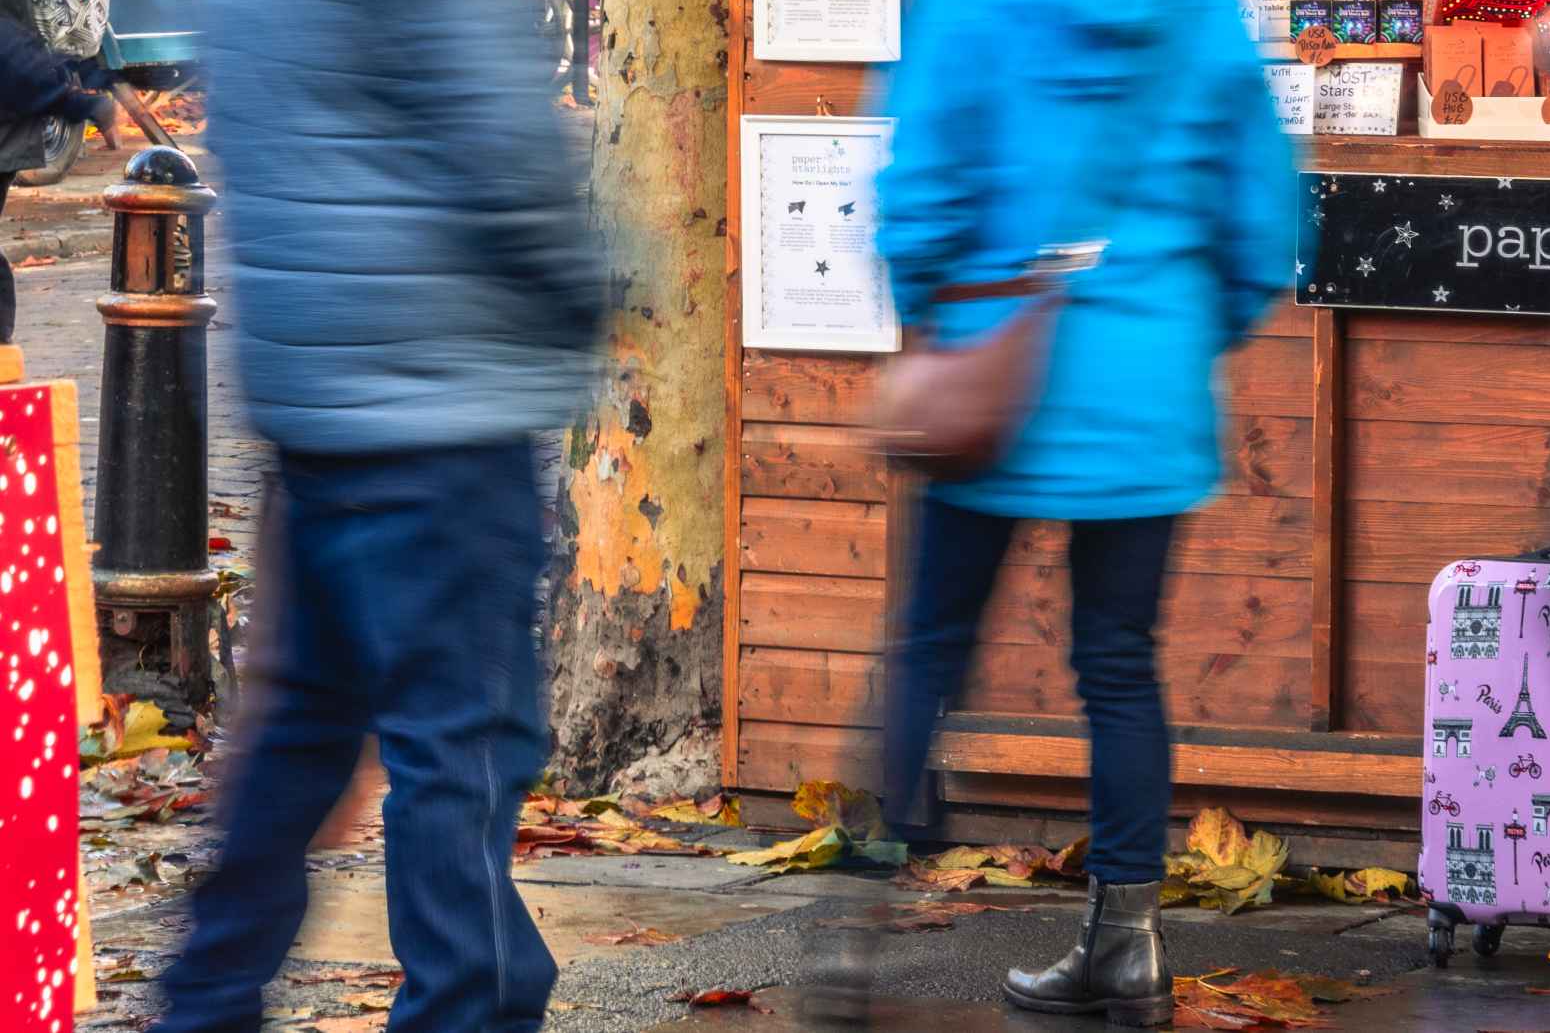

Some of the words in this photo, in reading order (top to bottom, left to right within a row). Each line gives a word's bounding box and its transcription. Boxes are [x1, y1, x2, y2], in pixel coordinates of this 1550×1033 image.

[1319, 84, 1355, 97] Stars
[1444, 92, 1469, 104] USB
[1319, 102, 1341, 111] Large
[1475, 684, 1503, 715] Paris
